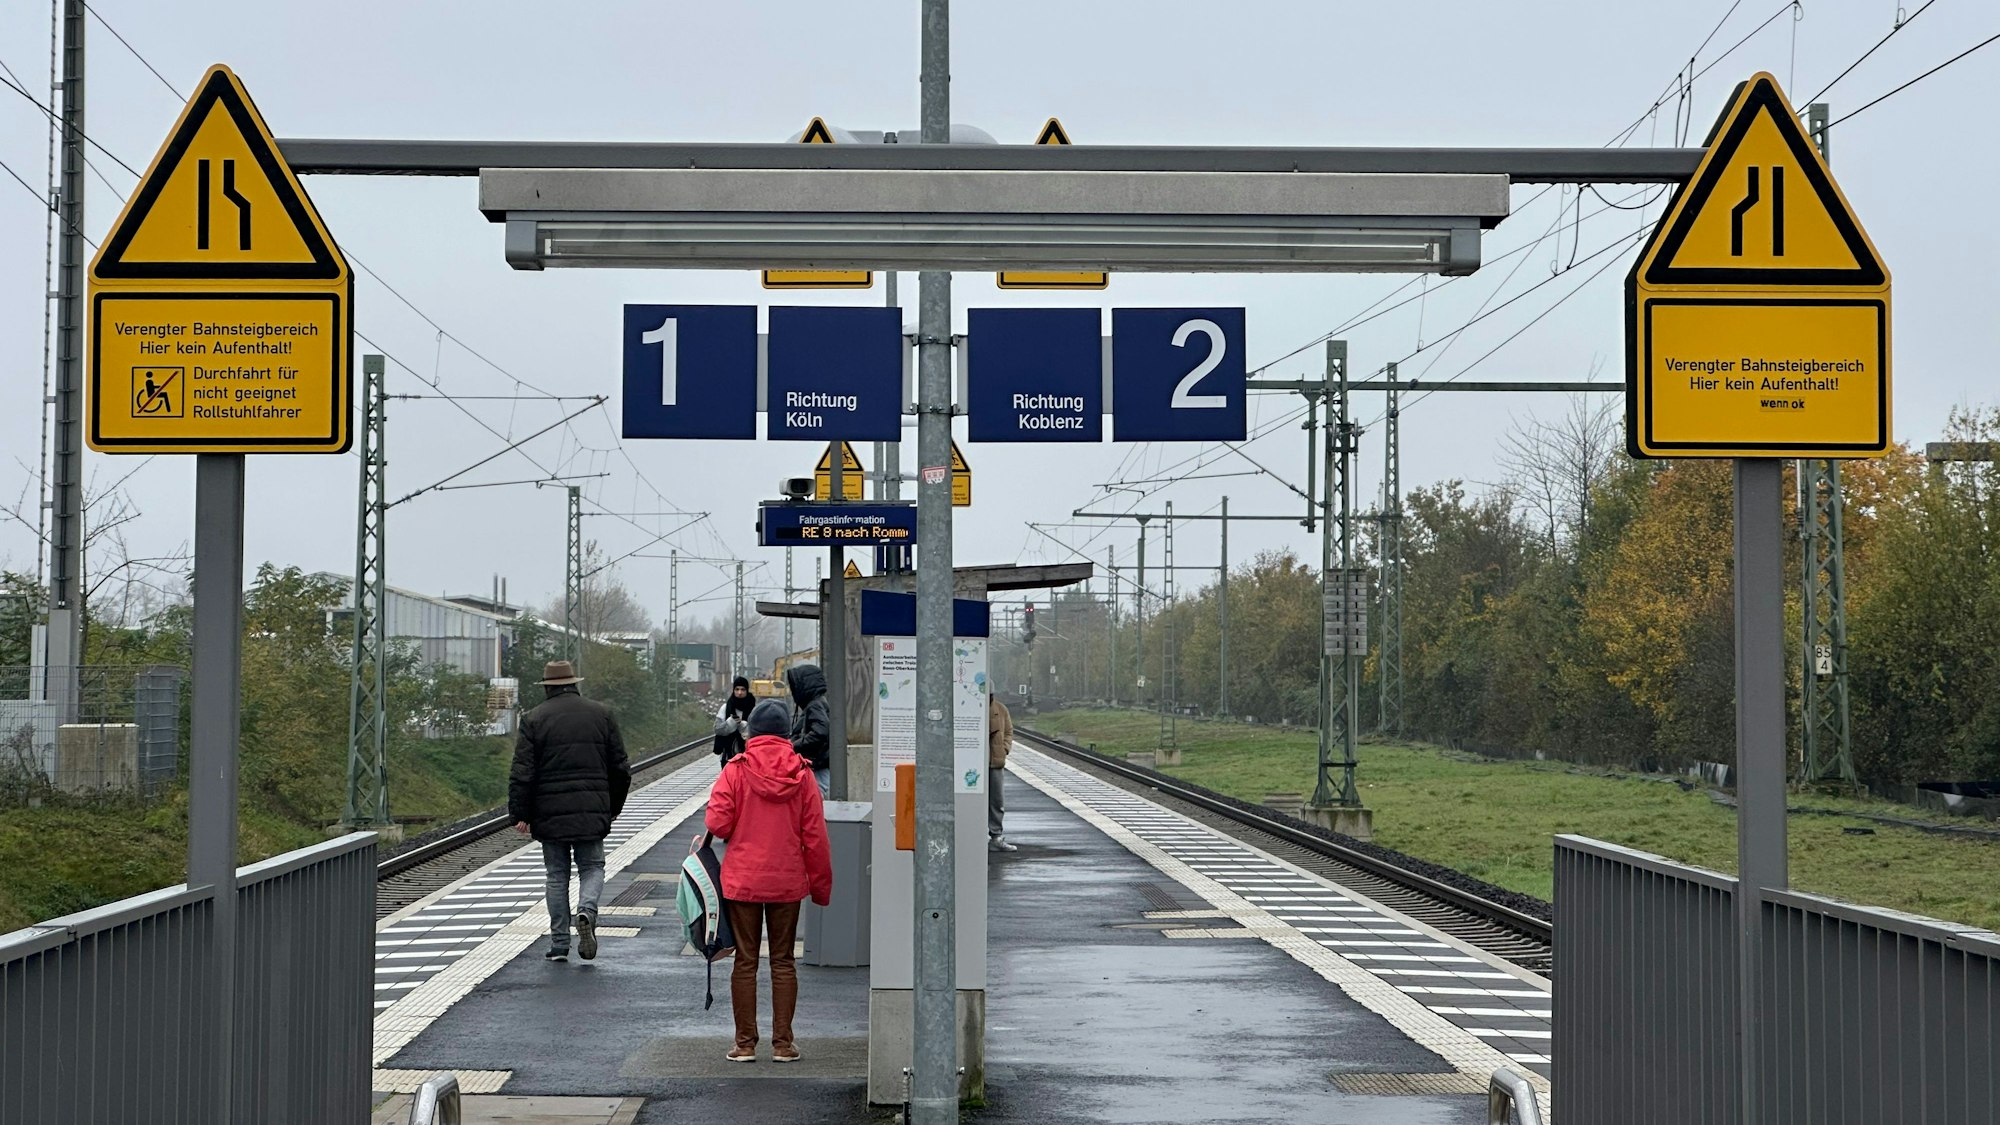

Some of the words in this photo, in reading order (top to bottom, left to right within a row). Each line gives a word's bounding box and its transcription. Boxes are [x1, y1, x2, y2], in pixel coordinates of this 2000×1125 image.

[115, 322, 188, 339] Verengter
[193, 322, 319, 338] Bahnsteigbereich
[140, 341, 171, 355] Hier
[176, 341, 207, 355] kein
[213, 341, 292, 355] Aufenthalt!
[643, 318, 678, 406] 1
[1171, 318, 1227, 409] 2
[1665, 358, 1736, 375] Verengter
[1741, 358, 1865, 375] Bahnsteigbereich
[193, 366, 272, 380] Durchfahrt
[277, 366, 300, 380] für
[1690, 377, 1720, 391] Hier
[1725, 377, 1755, 391] kein
[1761, 377, 1839, 391] Aufenthalt!
[193, 386, 229, 400] nicht
[234, 386, 297, 401] geeignet
[787, 392, 857, 412] Richtung
[1013, 393, 1084, 414] Richtung
[1760, 399, 1789, 409] wenn
[1791, 399, 1805, 409] ok
[193, 405, 303, 419] Rollstuhlfahrer
[787, 411, 823, 429] Köln
[1019, 412, 1084, 430] Koblenz
[802, 526, 819, 538] RE
[823, 526, 832, 538] 8
[835, 526, 869, 538] nach
[872, 526, 909, 538] Romm
[1816, 647, 1831, 658] 85
[1821, 660, 1828, 670] 4
